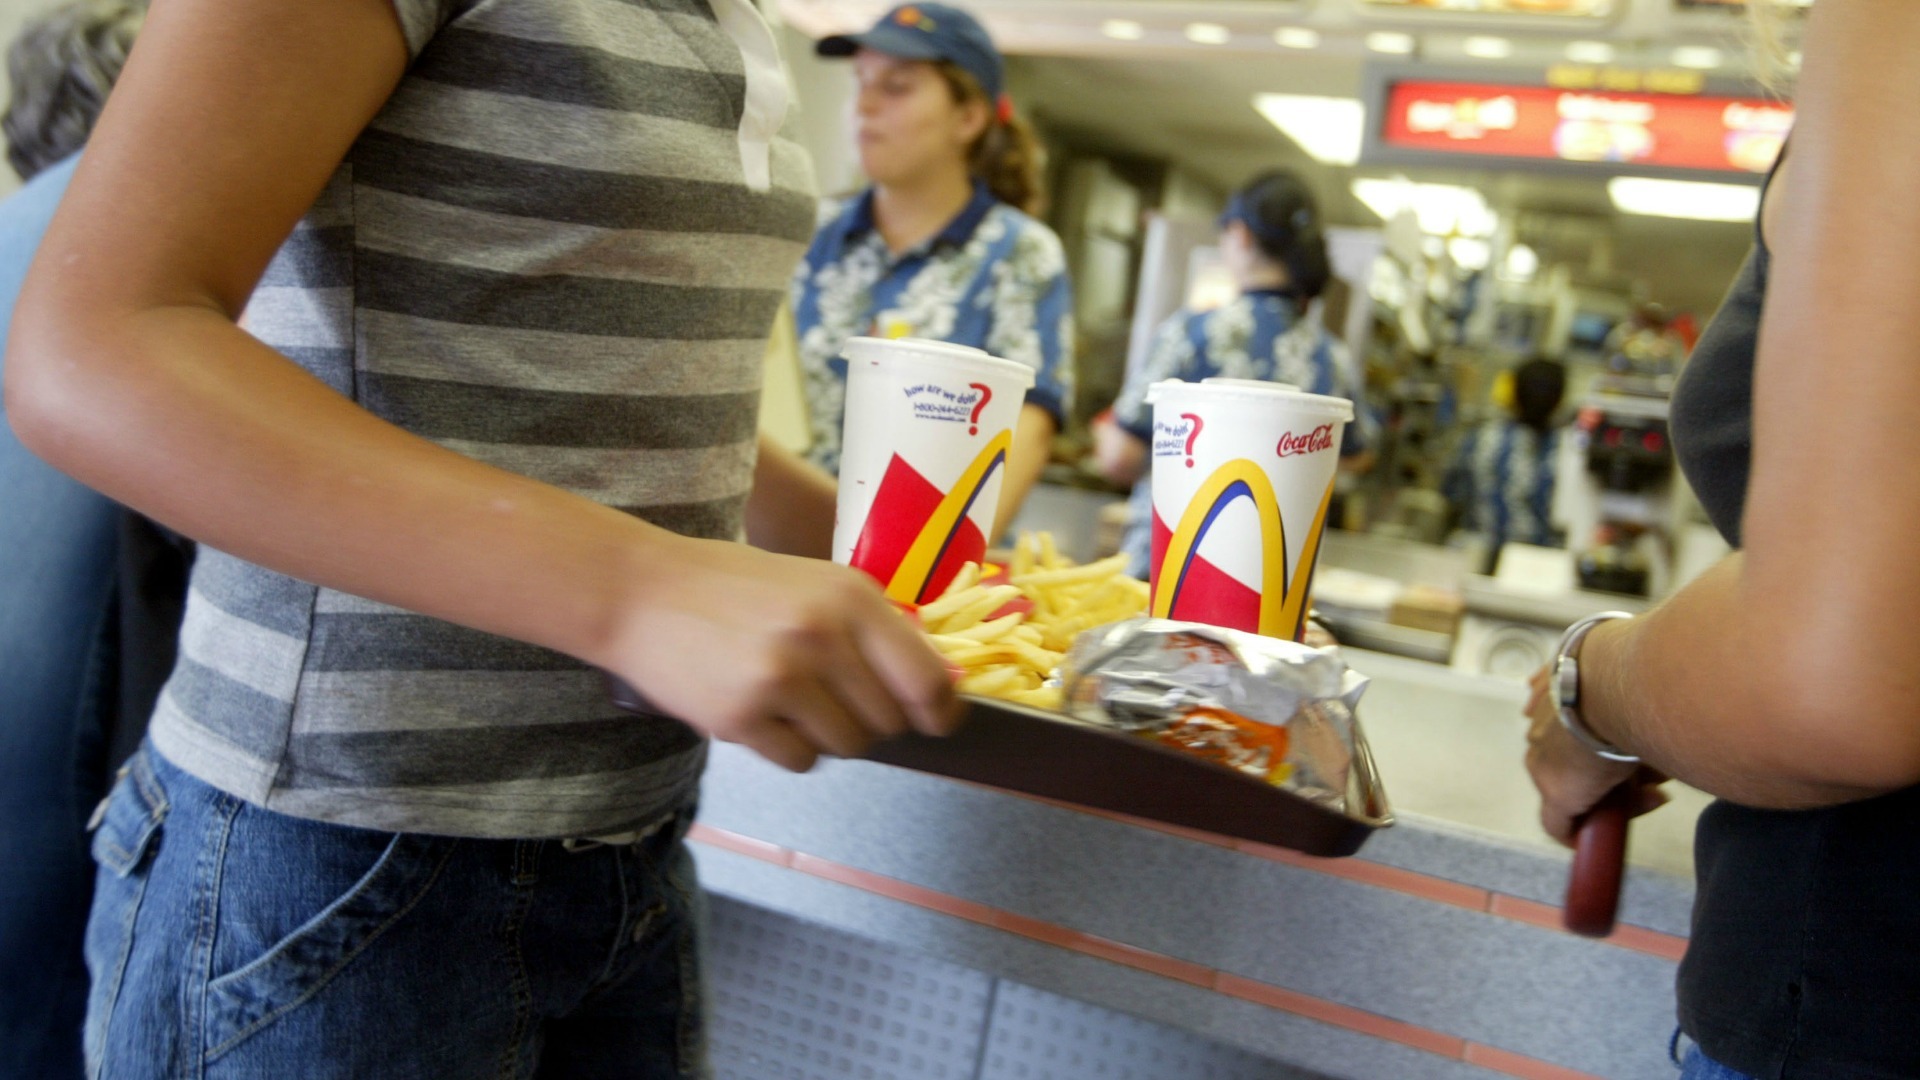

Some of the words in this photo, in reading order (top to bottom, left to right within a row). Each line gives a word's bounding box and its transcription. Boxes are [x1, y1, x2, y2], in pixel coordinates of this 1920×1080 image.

[904, 385, 925, 398] how
[927, 384, 942, 395] are
[943, 391, 956, 401] we
[1276, 422, 1334, 458] Coca-Cola
